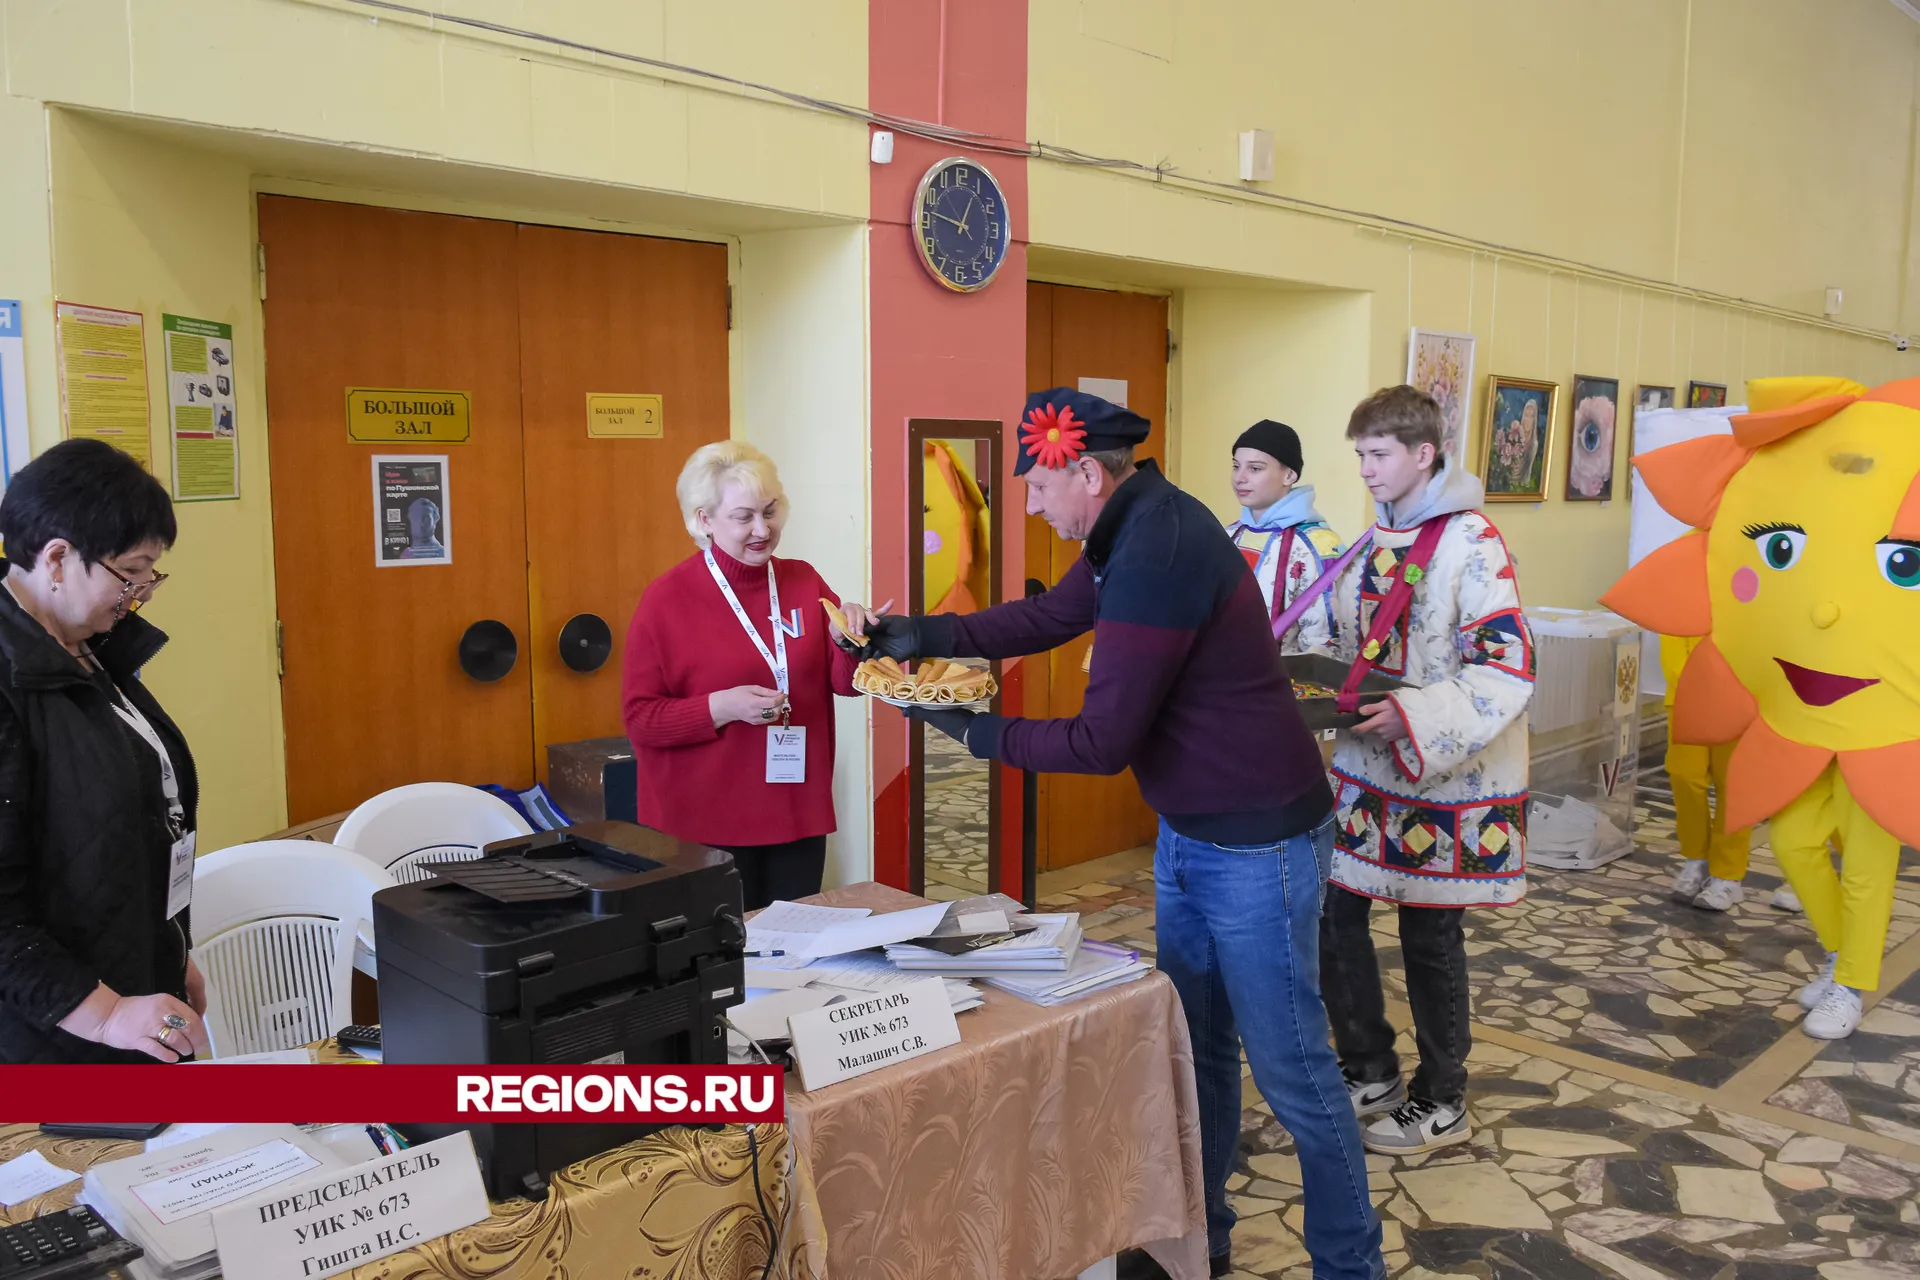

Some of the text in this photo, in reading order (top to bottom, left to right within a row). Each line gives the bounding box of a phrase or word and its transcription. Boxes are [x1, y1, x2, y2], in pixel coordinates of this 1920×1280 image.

[941, 171, 948, 188] 11
[956, 167, 967, 188] 12
[927, 188, 935, 205] 10
[986, 197, 995, 214] 2
[990, 222, 999, 239] 3
[926, 237, 934, 254] 8
[985, 246, 993, 263] 4
[938, 257, 946, 272] 7
[972, 262, 982, 280] 5
[955, 266, 964, 282] 6
[363, 400, 456, 416] БОЛЬШОЙ
[595, 406, 636, 415] БОЛЬШОЙ
[644, 408, 653, 424] 2
[394, 420, 433, 435] ЗАЛ
[608, 417, 624, 425] ЗАЛ
[396, 484, 440, 493] Пушкинской
[829, 993, 910, 1024] СЕКРЕТАРЬ
[838, 1015, 909, 1046] УИК № 673
[837, 1035, 927, 1071] Малашич С.В.
[190, 1162, 256, 1189] ЖУРНАЛ
[258, 1152, 441, 1224] ПРЕДСЕДАТЕЛЬ
[294, 1192, 411, 1245] УИК № 673
[301, 1223, 421, 1277] Гишта Н.С.
